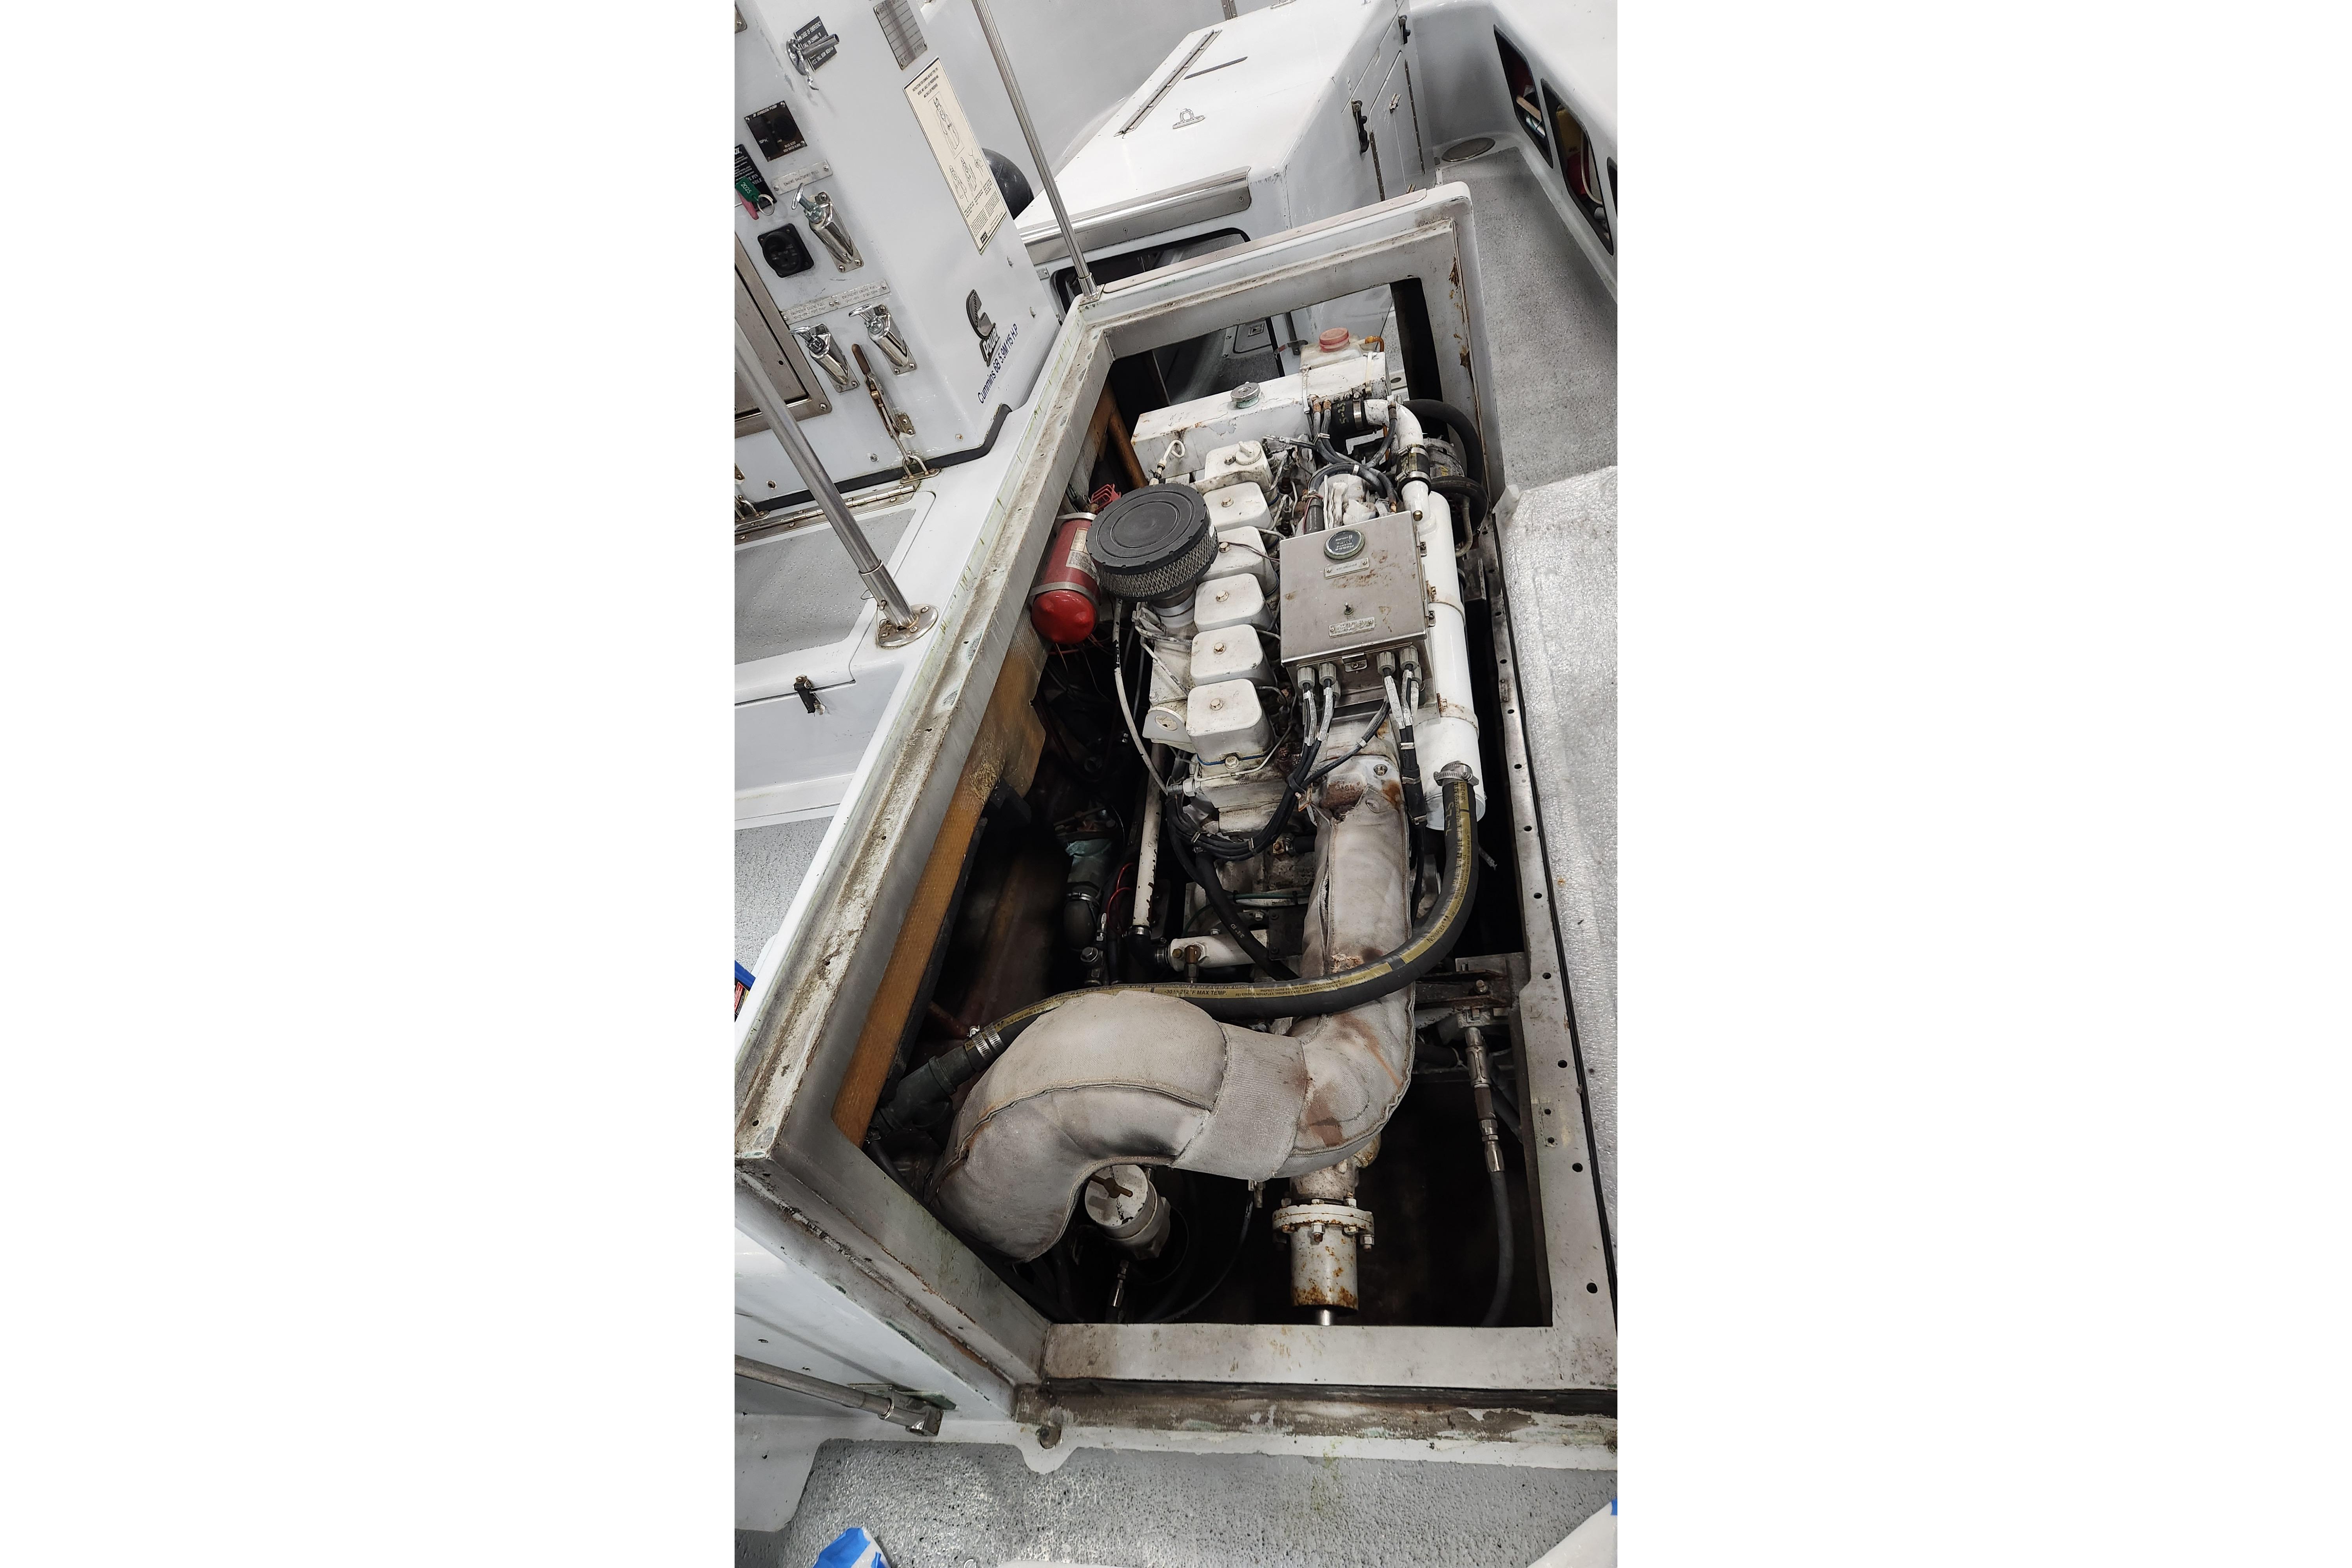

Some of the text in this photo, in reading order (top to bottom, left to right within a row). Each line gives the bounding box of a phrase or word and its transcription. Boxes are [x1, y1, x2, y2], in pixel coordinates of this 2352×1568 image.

[740, 182, 752, 194] 2025
[978, 370, 996, 404] Cummins
[993, 358, 1001, 374] 6B
[1426, 924, 1446, 944] NOVAFLEX
